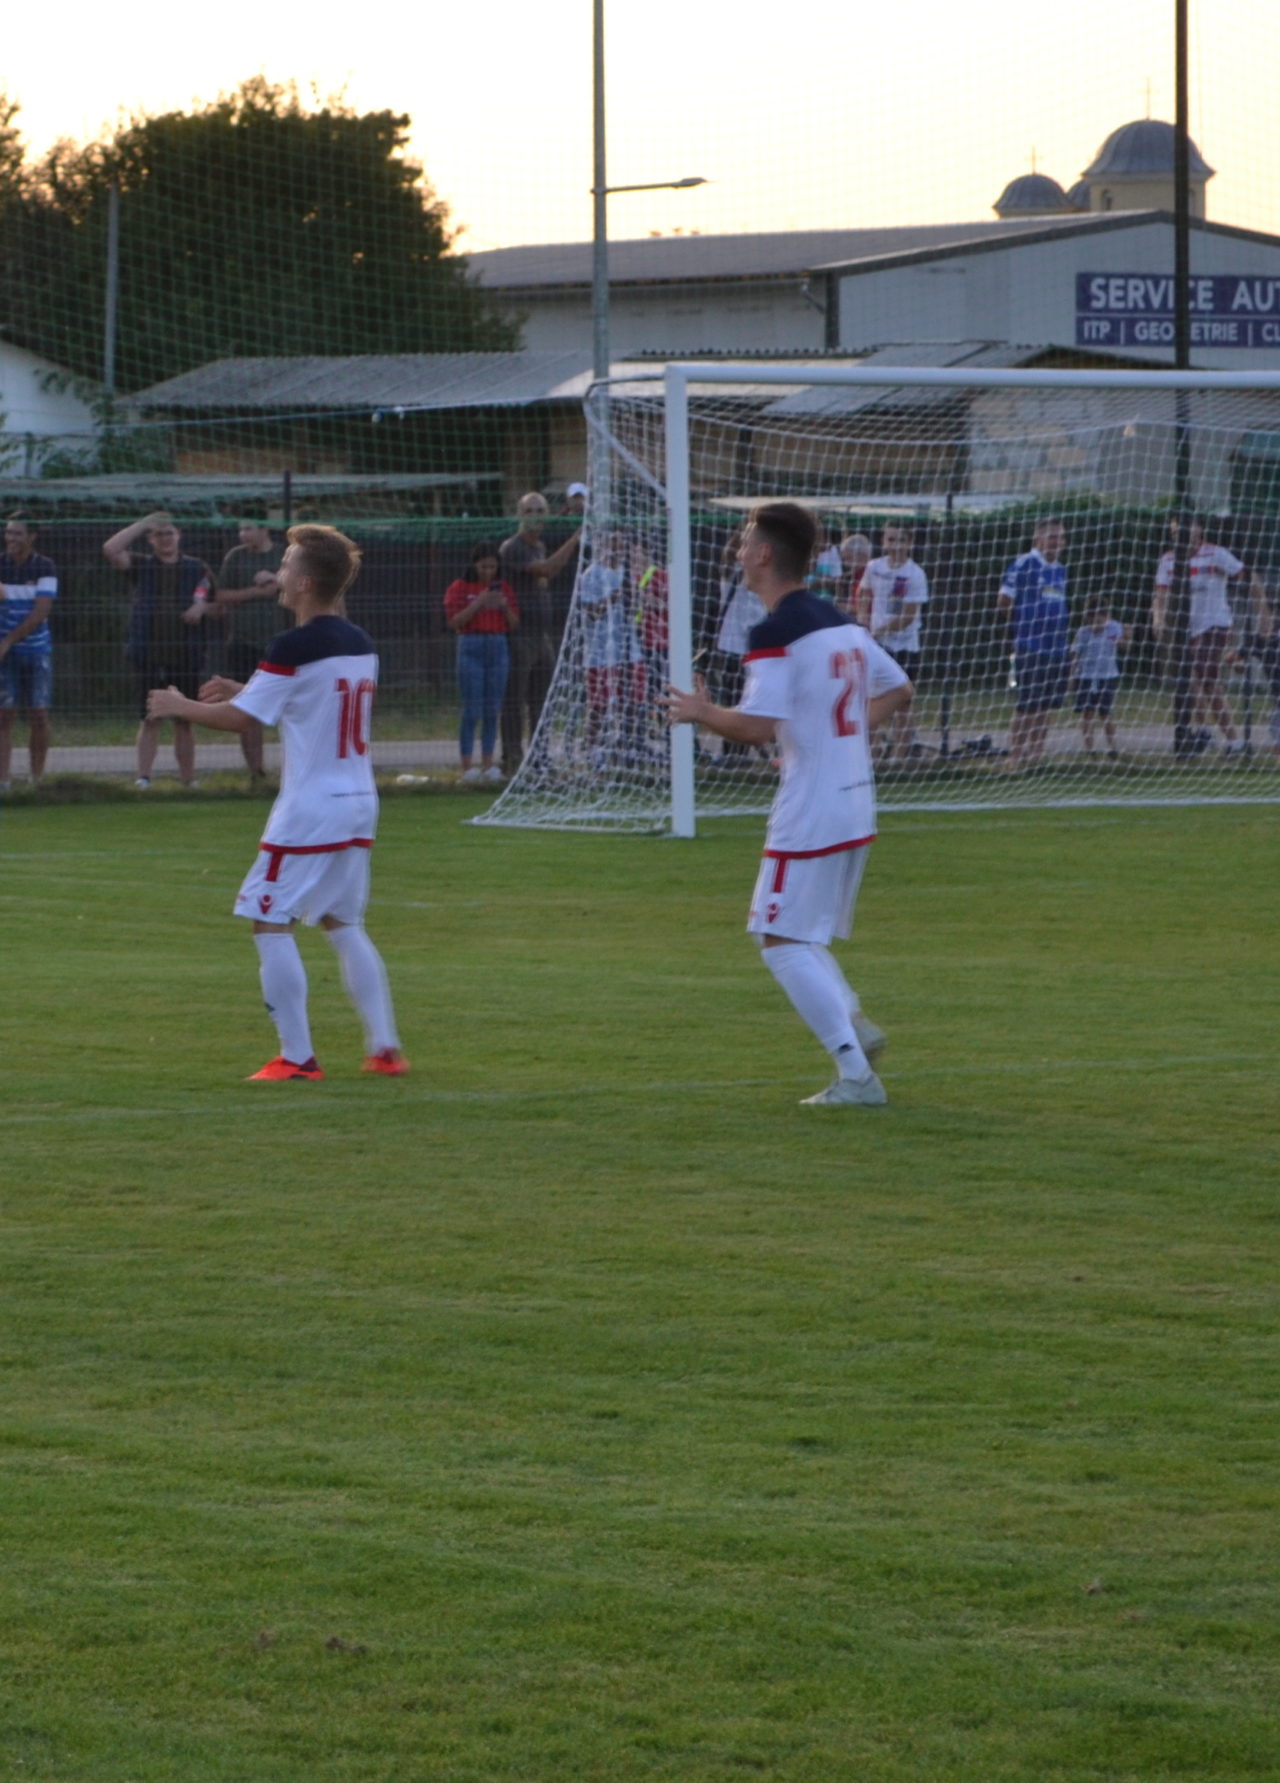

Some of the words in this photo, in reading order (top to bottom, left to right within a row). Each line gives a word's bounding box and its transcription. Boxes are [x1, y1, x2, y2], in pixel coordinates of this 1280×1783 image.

[1090, 278, 1214, 311] SERVIE
[1083, 321, 1111, 340] ITP
[1134, 321, 1238, 342] GEOETRIE
[335, 677, 377, 760] 10
